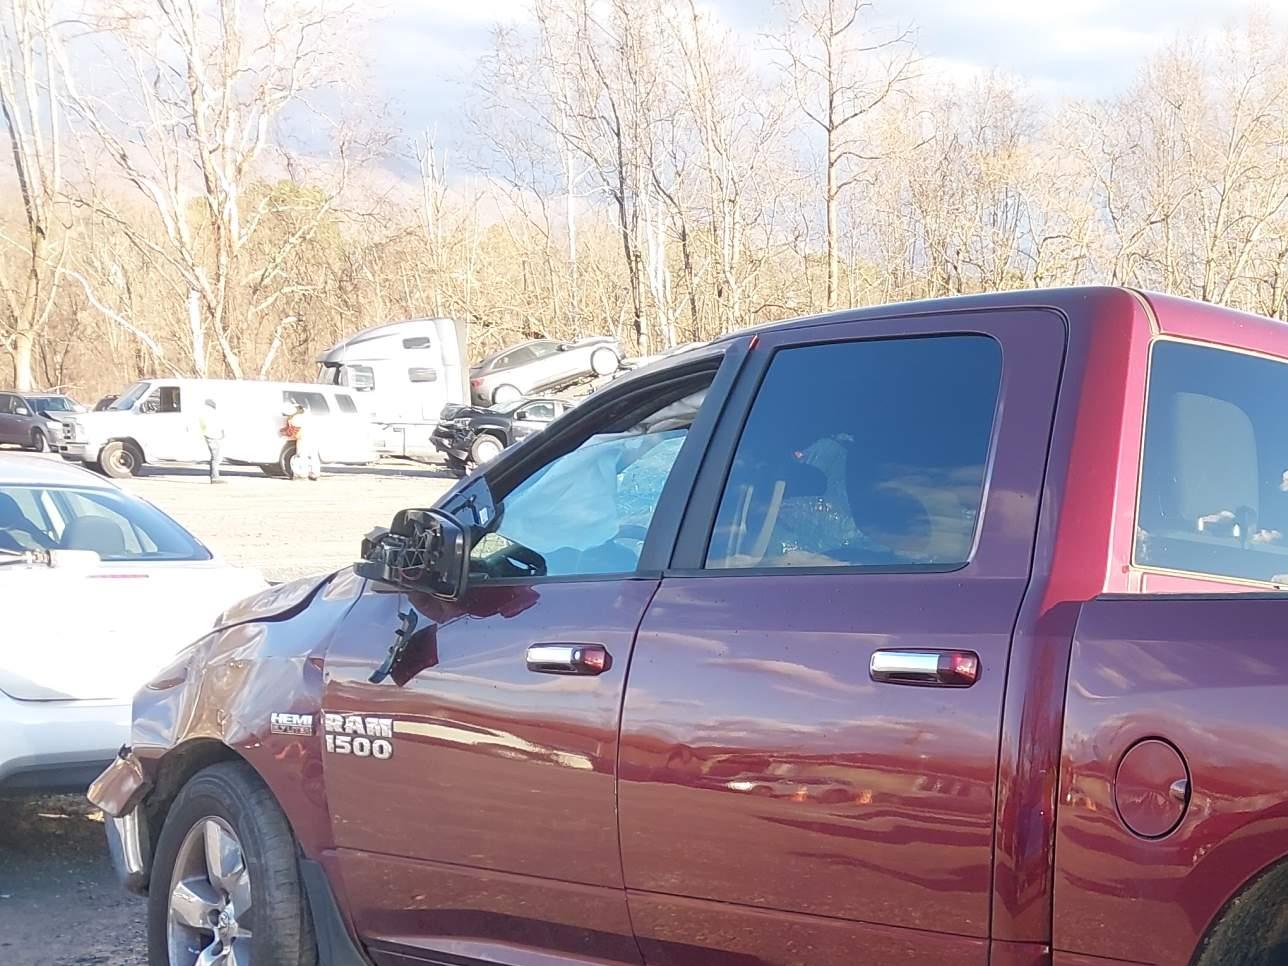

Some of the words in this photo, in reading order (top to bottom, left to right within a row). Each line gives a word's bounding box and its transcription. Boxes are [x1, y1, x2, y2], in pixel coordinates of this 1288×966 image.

[271, 712, 313, 725] HEMI
[325, 713, 393, 738] RAM
[325, 735, 393, 760] 1500
